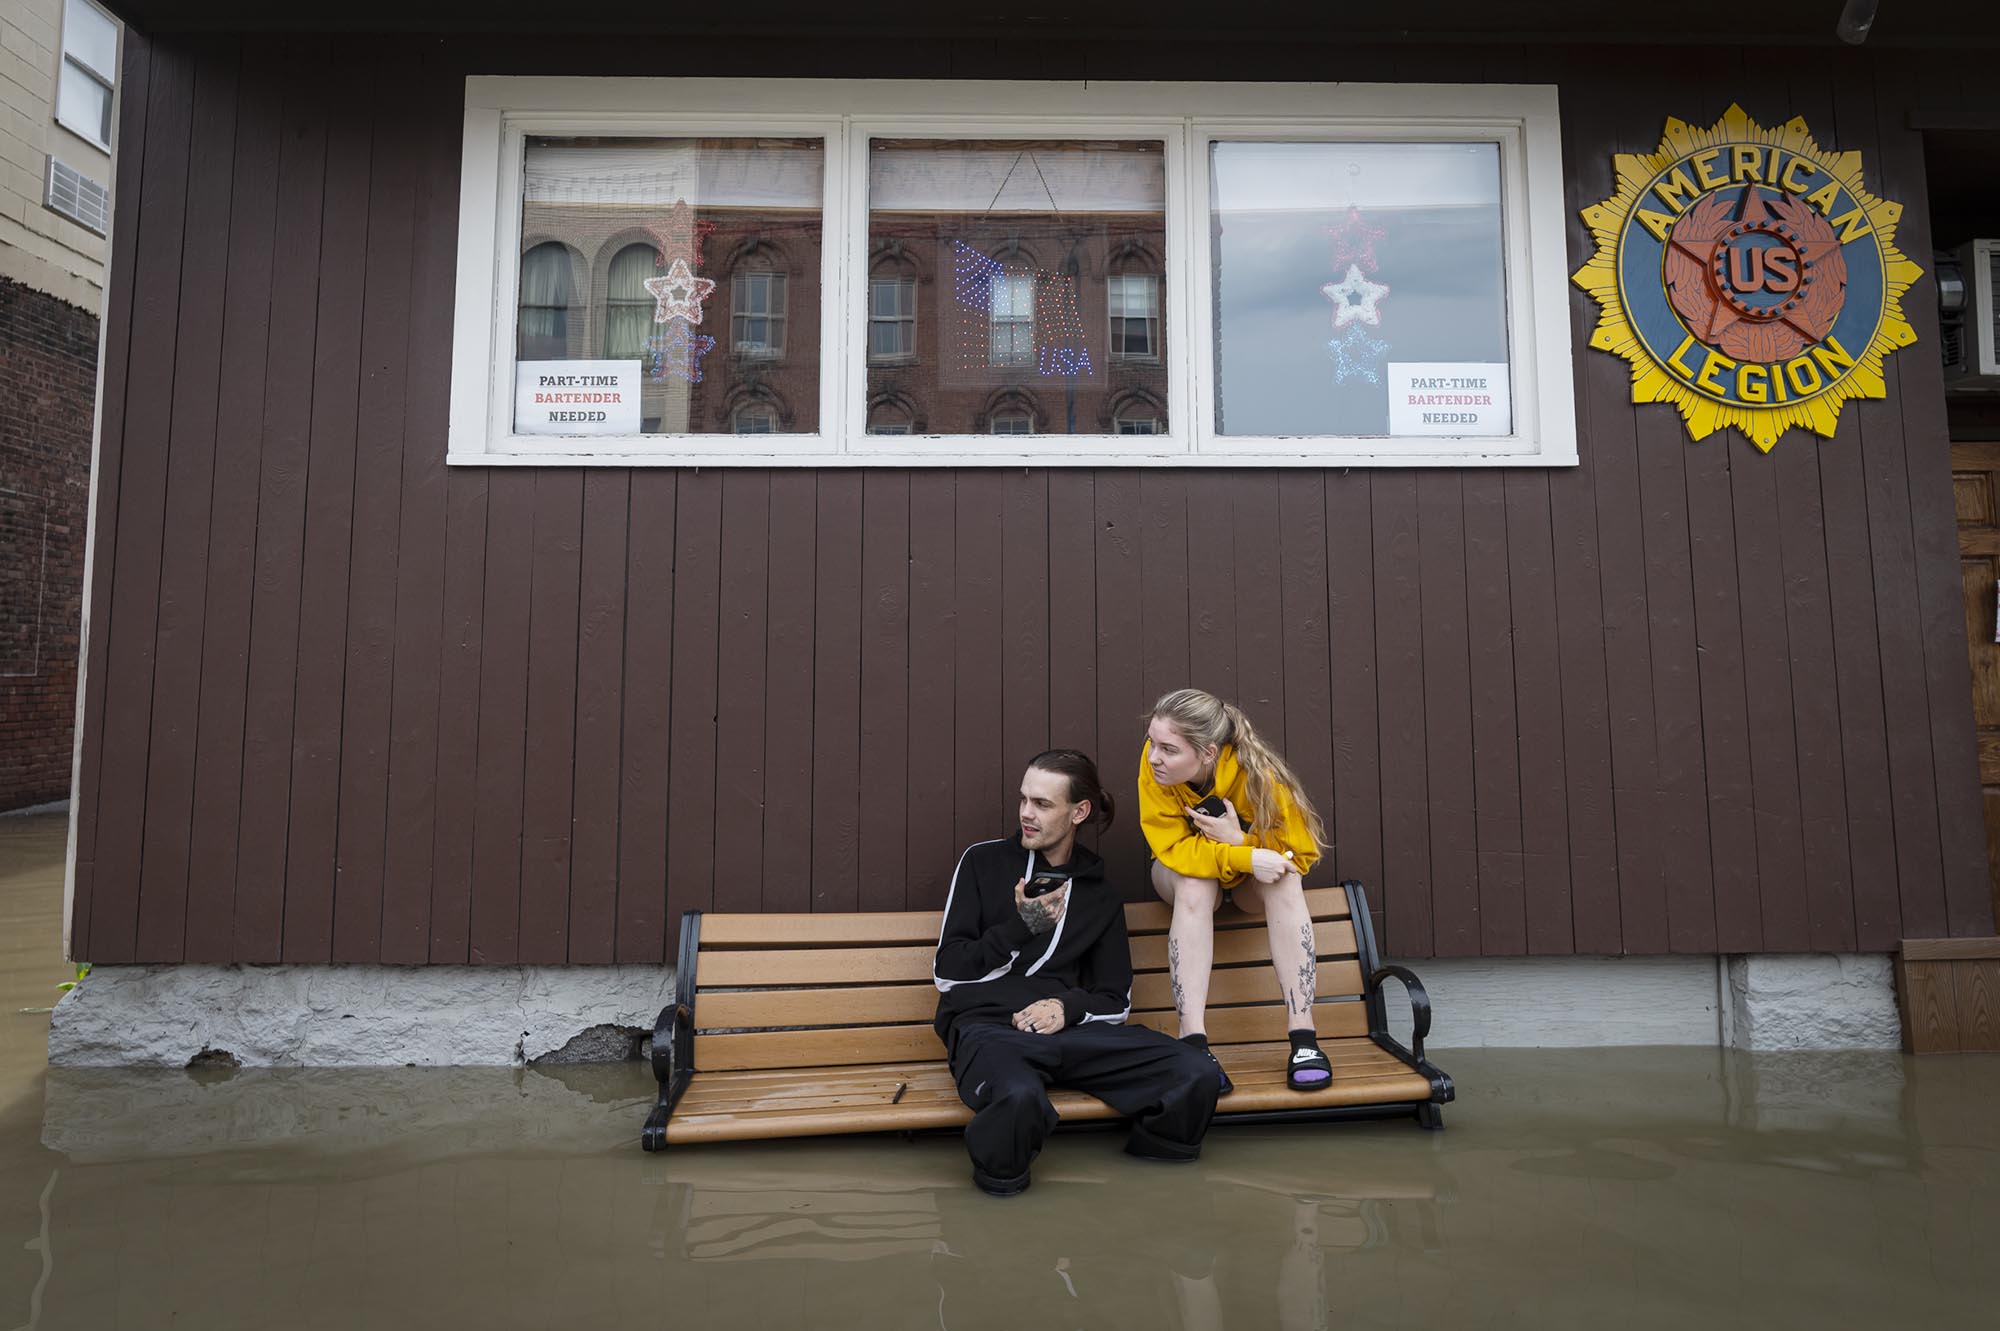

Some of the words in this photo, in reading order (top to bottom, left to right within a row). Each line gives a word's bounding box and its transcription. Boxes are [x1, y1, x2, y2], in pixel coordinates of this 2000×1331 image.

[1634, 145, 1872, 246] AMERICAN
[1726, 246, 1800, 294] US
[1039, 346, 1093, 375] USA
[1666, 335, 1856, 403] LEGION
[539, 375, 618, 386] PART-TIME
[1411, 377, 1487, 388] PART-TIME
[535, 392, 621, 403] BARTENDER
[1408, 394, 1492, 405] BARTENDER
[549, 411, 606, 422] NEEDED
[1422, 412, 1478, 423] NEEDED
[1297, 1048, 1318, 1057] NIKE
